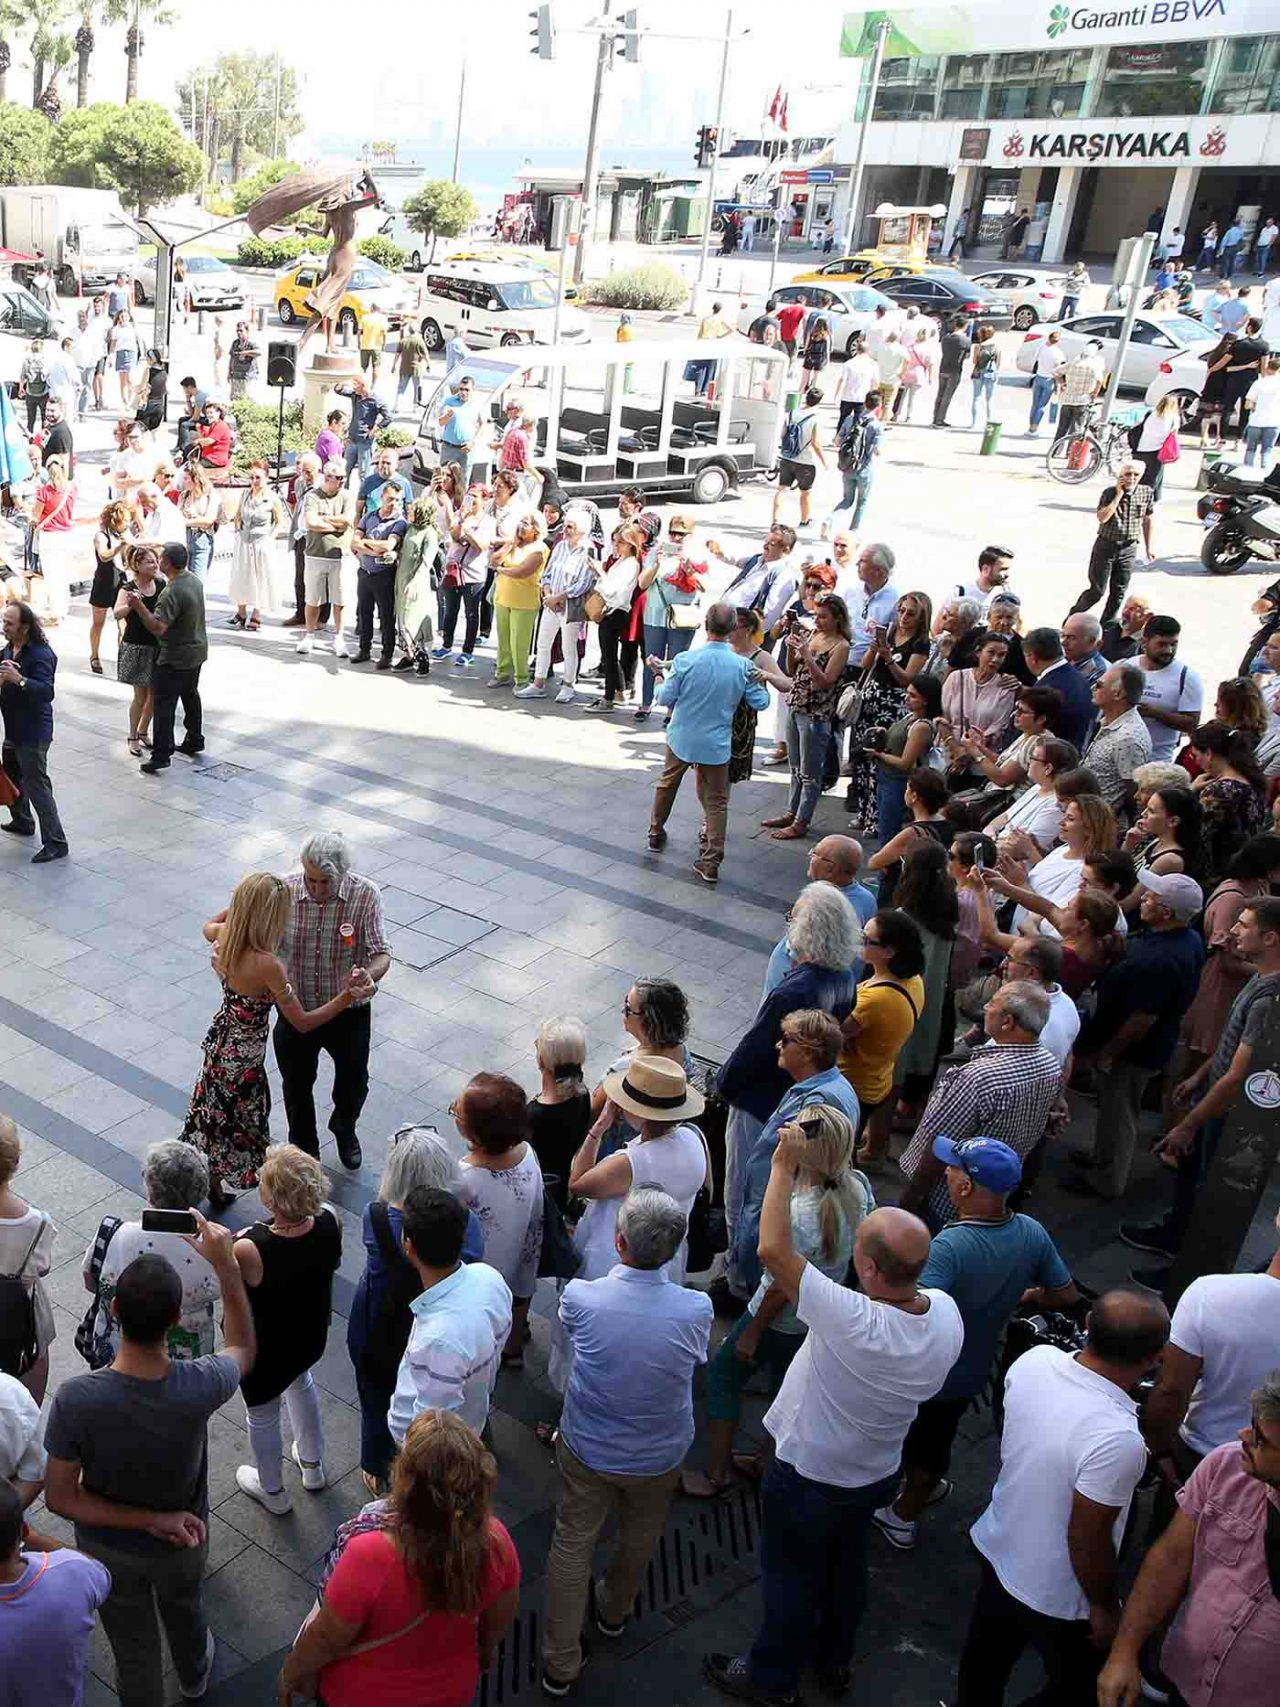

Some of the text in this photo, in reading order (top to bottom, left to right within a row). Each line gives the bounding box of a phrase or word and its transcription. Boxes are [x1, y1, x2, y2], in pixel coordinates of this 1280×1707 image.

[1071, 0, 1227, 30] Garanti BBVA
[1028, 131, 1191, 162] KARŞIYAKA
